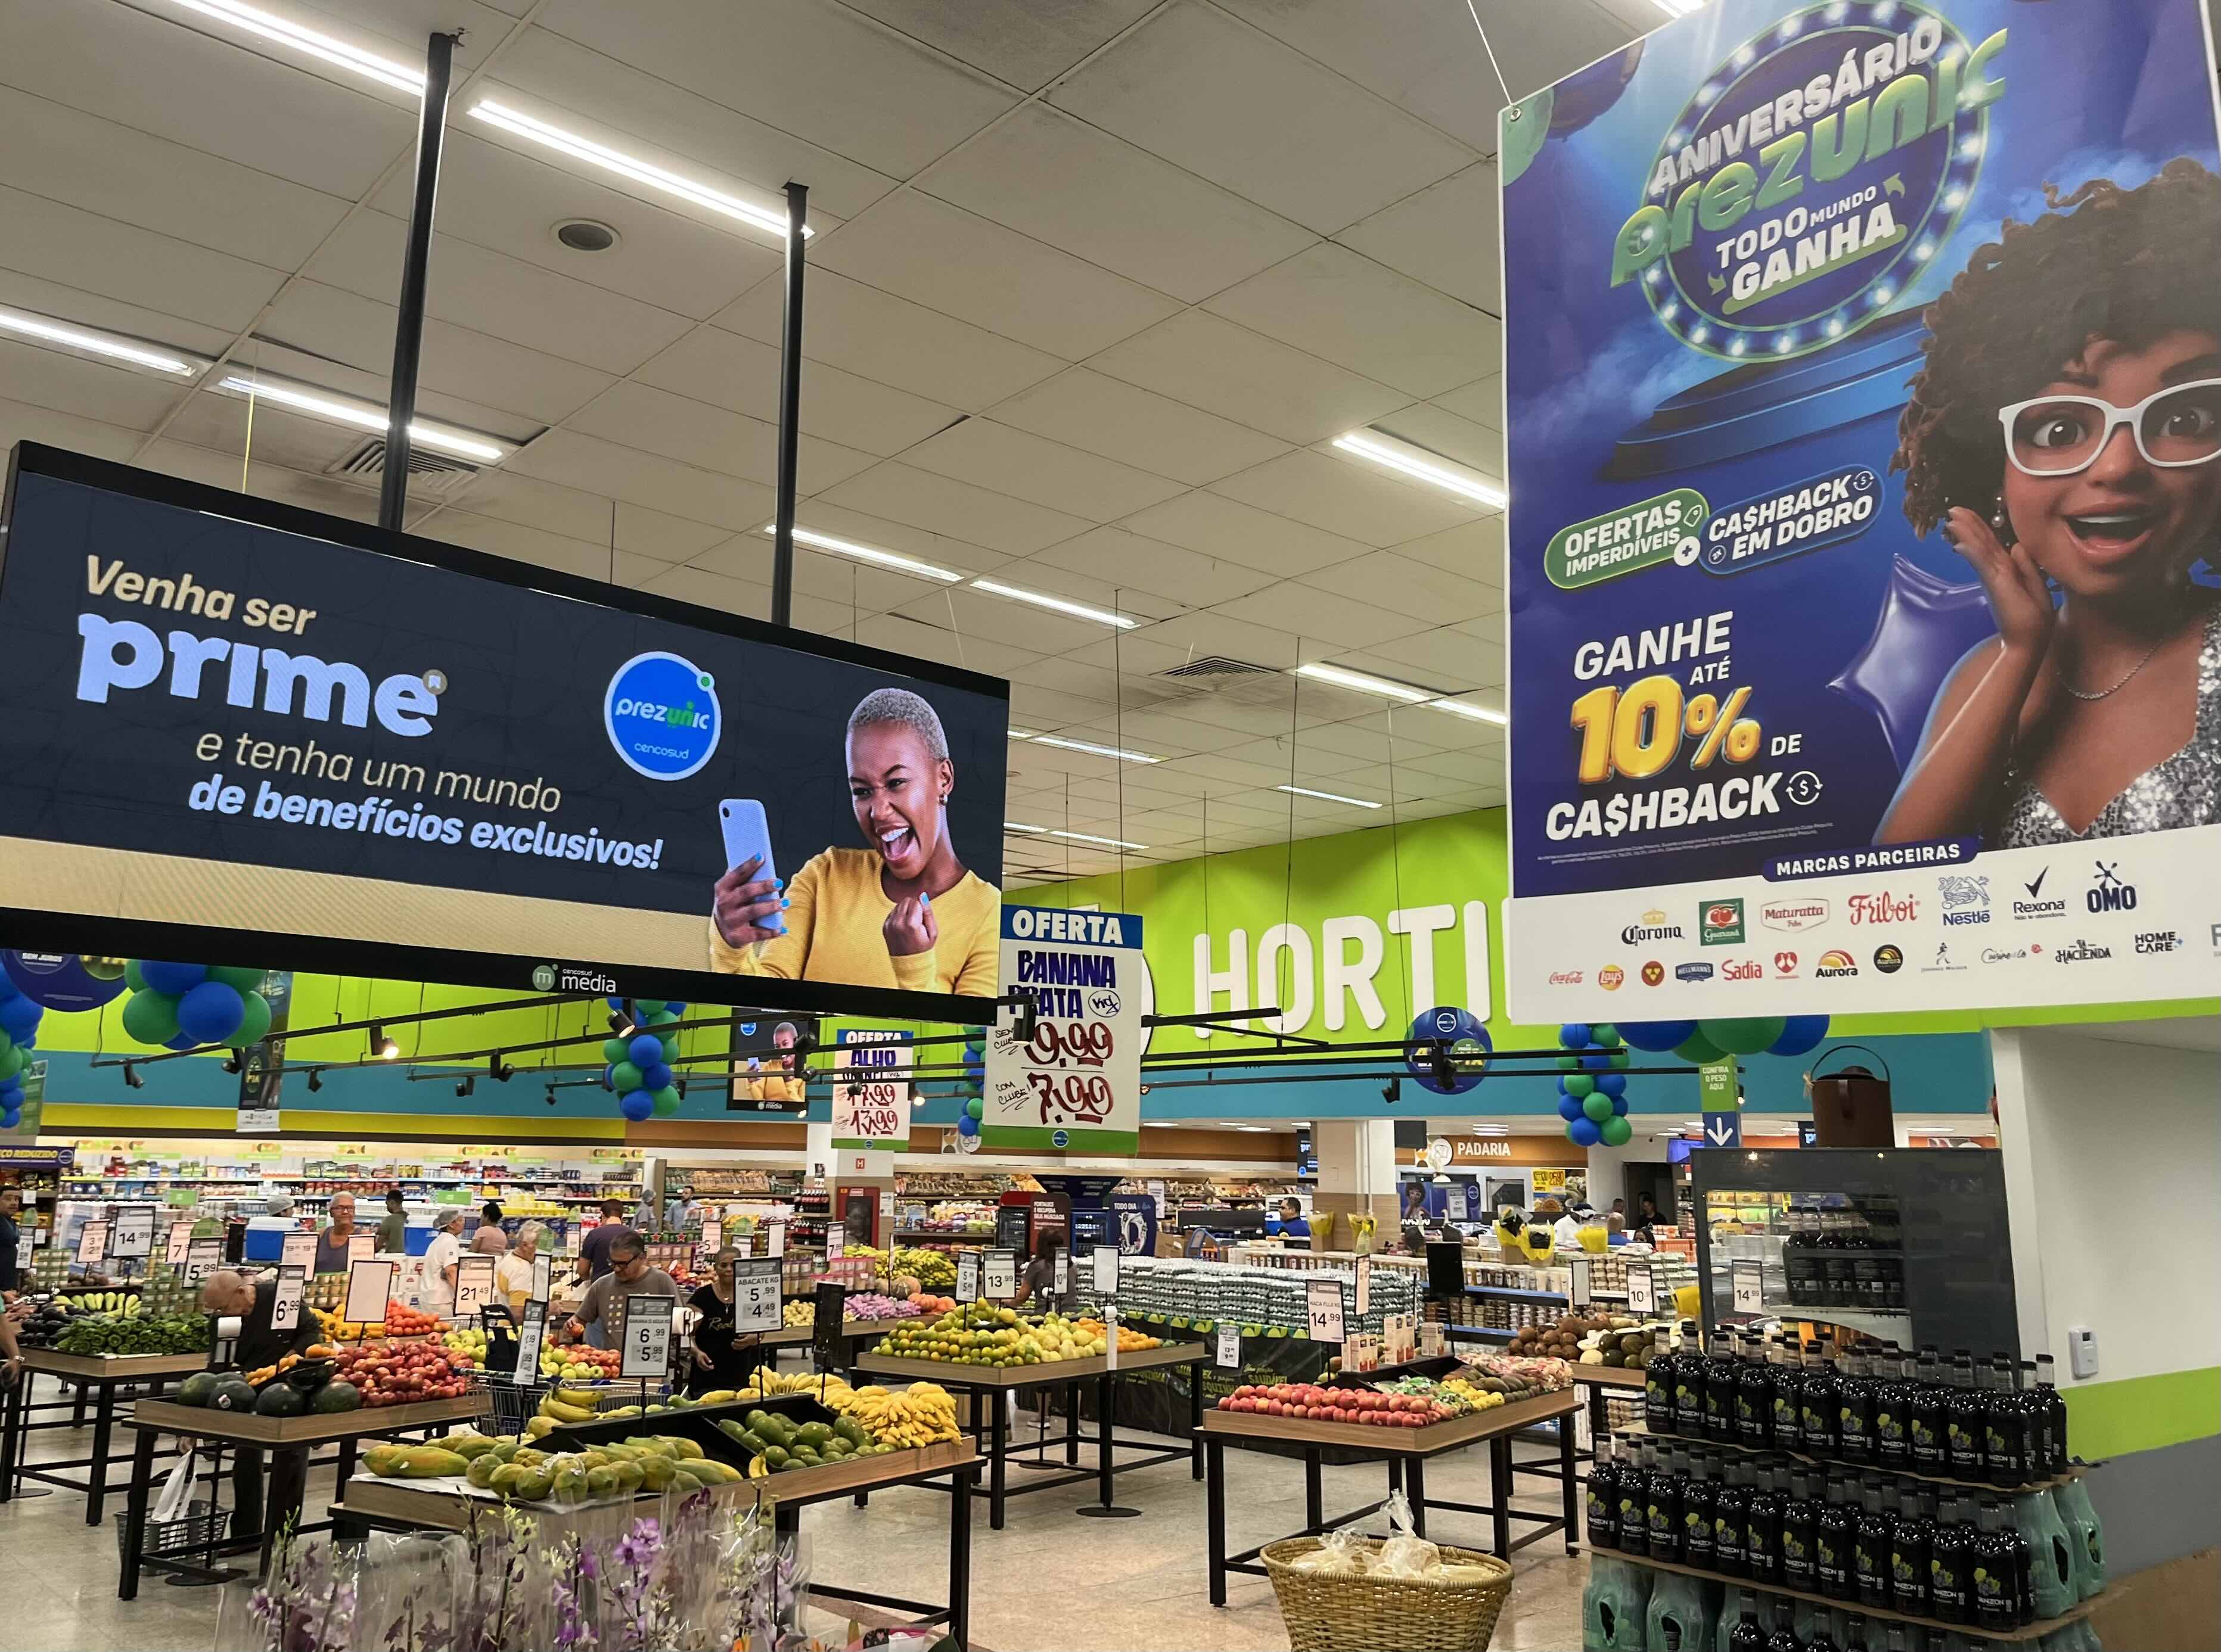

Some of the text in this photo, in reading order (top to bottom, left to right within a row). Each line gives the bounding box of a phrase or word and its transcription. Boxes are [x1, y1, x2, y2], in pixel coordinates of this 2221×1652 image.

[1648, 18, 1943, 197] ANIVERSÁRIO
[1716, 186, 1877, 269] TODO MUNDO
[1732, 203, 1897, 301] GANHA
[1709, 474, 1852, 542] CA$HBACK
[1564, 499, 1682, 558] OFERTAS
[1732, 527, 1772, 560] EM
[1776, 495, 1872, 546] DOBRO
[1565, 528, 1680, 577] IMPERDÍVEIS
[87, 555, 316, 635] Venha ser
[1573, 610, 1733, 682] GANHE
[76, 613, 439, 737] prime
[1689, 655, 1731, 686] ATÉ
[615, 698, 710, 729] prezunic
[1570, 674, 1802, 784] 10% DE
[634, 743, 689, 759] cencosud
[196, 733, 560, 813] e tenha um mundo
[188, 774, 664, 870] de benefícios exclusivos!
[1546, 771, 1784, 841] CA$HBACK
[1776, 844, 1961, 877] MARCAS PARCEIRAS
[1765, 906, 1824, 920] Maturatta
[1848, 891, 1917, 925] Friboi
[2013, 900, 2065, 914] Rexona
[2086, 885, 2136, 914] OMO
[1012, 910, 1123, 944] OFERTA
[1622, 925, 1683, 946] Corona
[2135, 931, 2176, 944] HOME
[2055, 947, 2112, 964] HACIENDA
[2135, 942, 2173, 954] CARE
[562, 975, 616, 993] media
[1017, 950, 1116, 988] BANANA
[1194, 900, 1512, 1039] HORTI
[1722, 959, 1762, 981] Sadia
[1816, 967, 1858, 978] Aurora
[850, 1050, 896, 1066] ALHO
[1458, 1142, 1511, 1156] PADARIA
[738, 1277, 769, 1286] ABACATE
